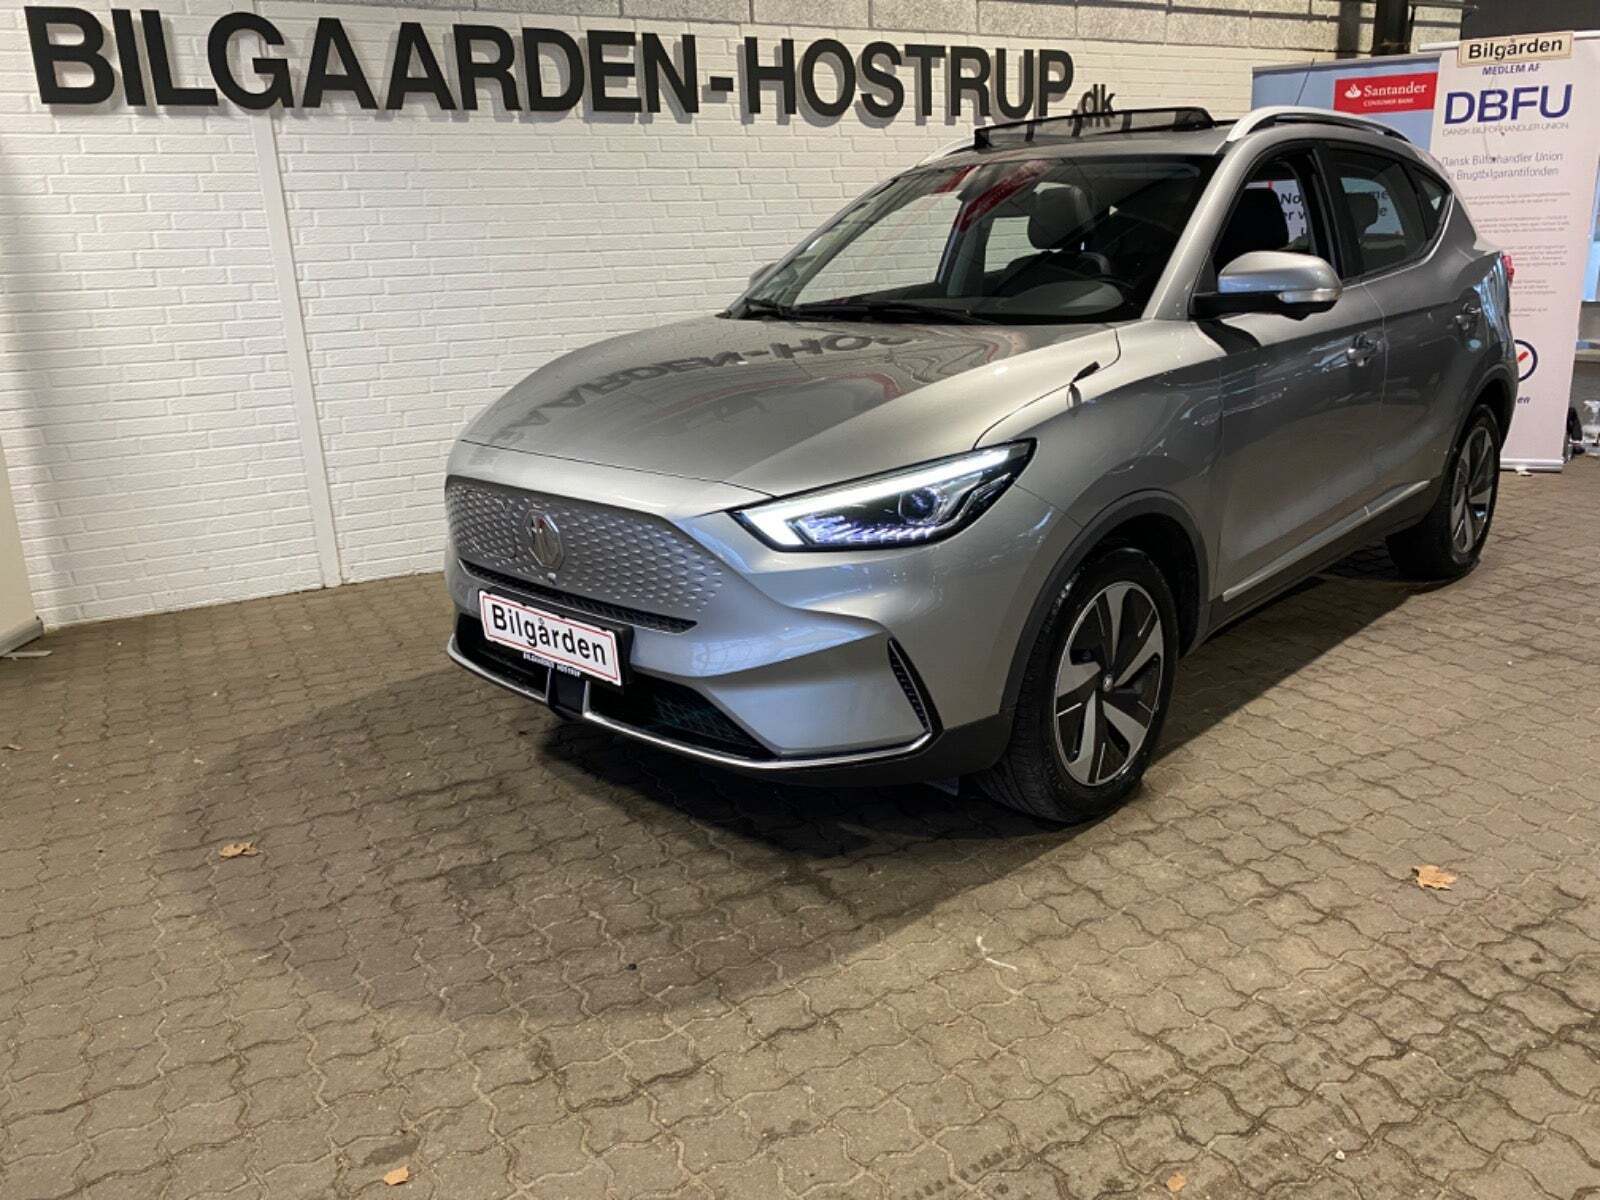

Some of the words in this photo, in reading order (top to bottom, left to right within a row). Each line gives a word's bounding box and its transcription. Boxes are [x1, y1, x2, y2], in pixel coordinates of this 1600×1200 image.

[1468, 38, 1563, 61] Bilgården
[1482, 63, 1526, 75] MEDLEM
[1528, 62, 1541, 72] AF
[1363, 81, 1428, 97] Santander
[1444, 84, 1573, 124] DBFU
[1535, 152, 1563, 162] Union
[492, 604, 606, 665] Bilgården
